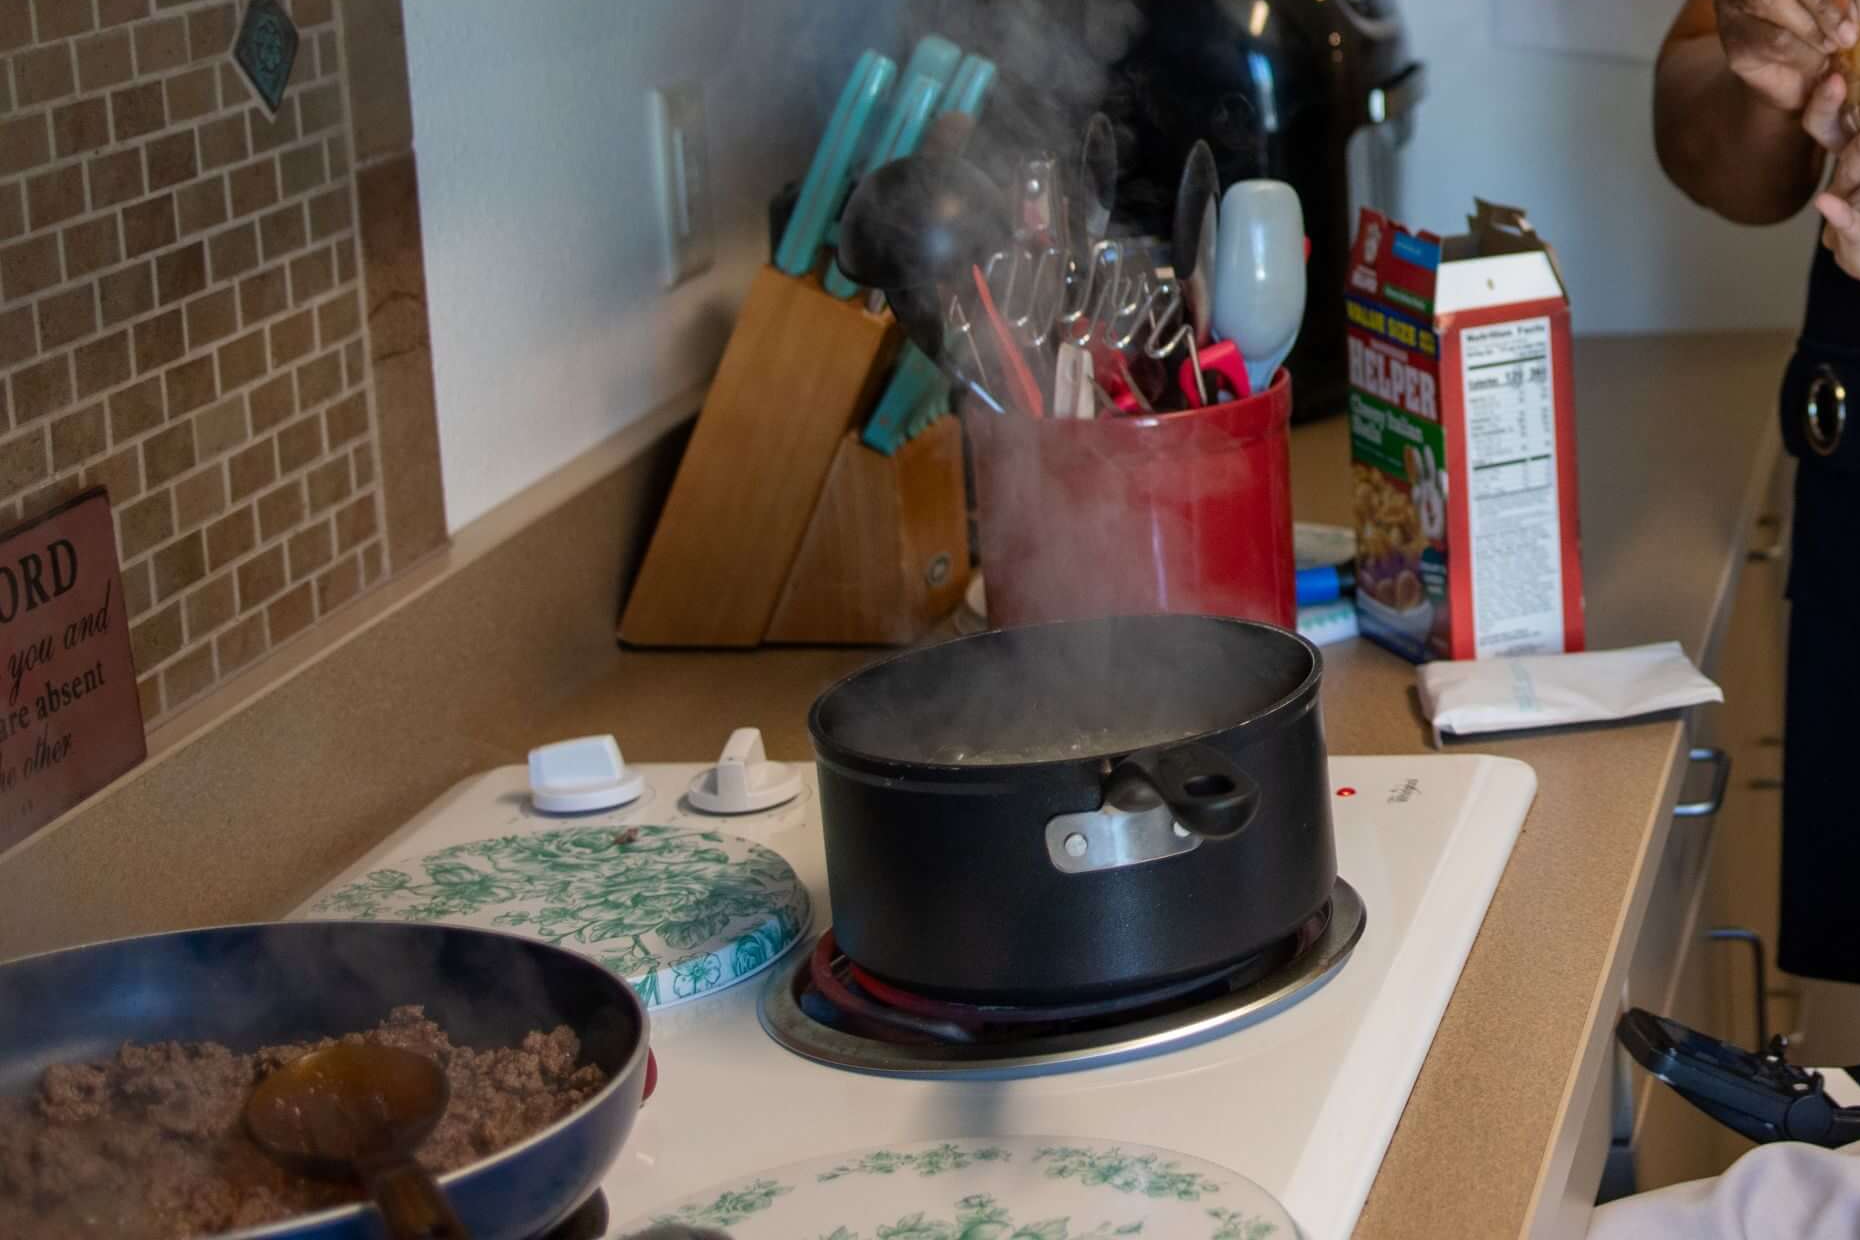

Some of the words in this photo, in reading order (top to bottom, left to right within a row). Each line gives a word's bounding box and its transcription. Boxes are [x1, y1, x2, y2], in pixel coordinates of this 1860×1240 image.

[1348, 335, 1438, 422] HELPER
[8, 635, 54, 707] you
[64, 578, 111, 650] and
[36, 660, 105, 721] absent
[23, 721, 72, 779] other
